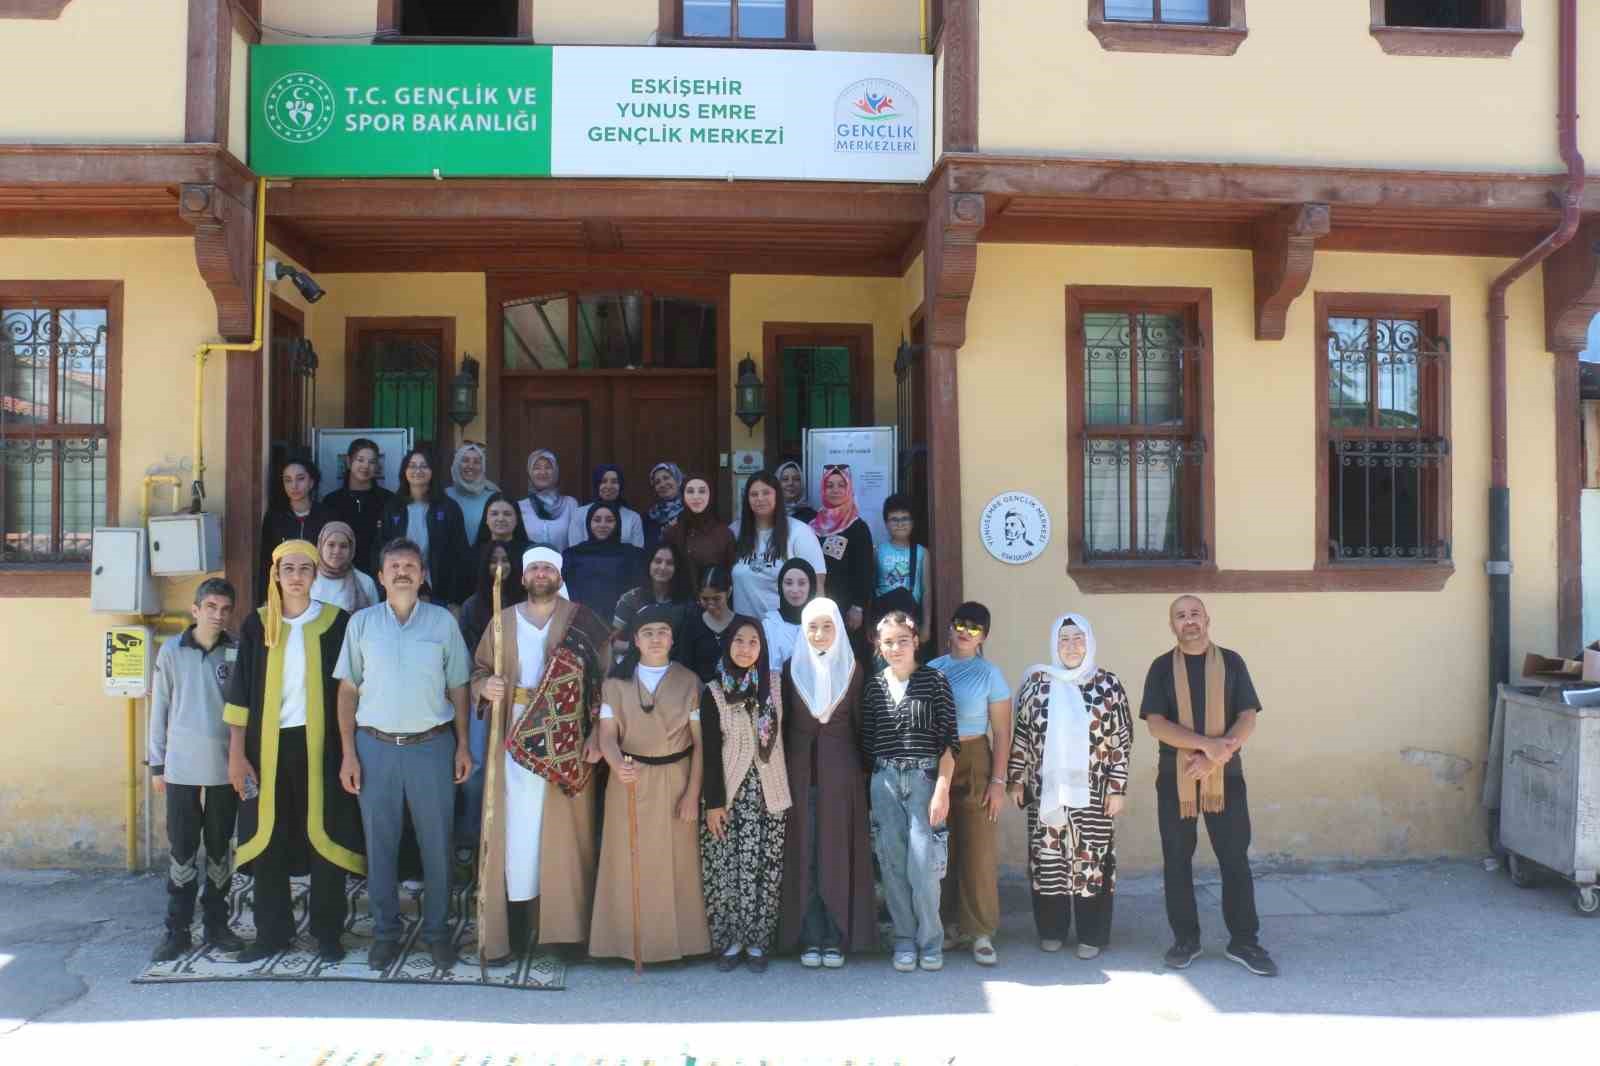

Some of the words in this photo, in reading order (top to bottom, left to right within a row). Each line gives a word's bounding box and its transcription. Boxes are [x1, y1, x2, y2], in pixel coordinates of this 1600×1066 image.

[345, 86, 387, 105] T.C.
[394, 83, 498, 110] GENÇLİK
[507, 87, 537, 105] VE
[631, 75, 742, 97] ESKİŞEHİR
[345, 113, 405, 132] SPOR
[412, 109, 537, 132] BAKANLIĞI
[616, 102, 691, 119] YUNUS
[698, 103, 756, 120] EMRE
[587, 123, 682, 145] GENÇLİK
[689, 126, 784, 145] MERKEZİ
